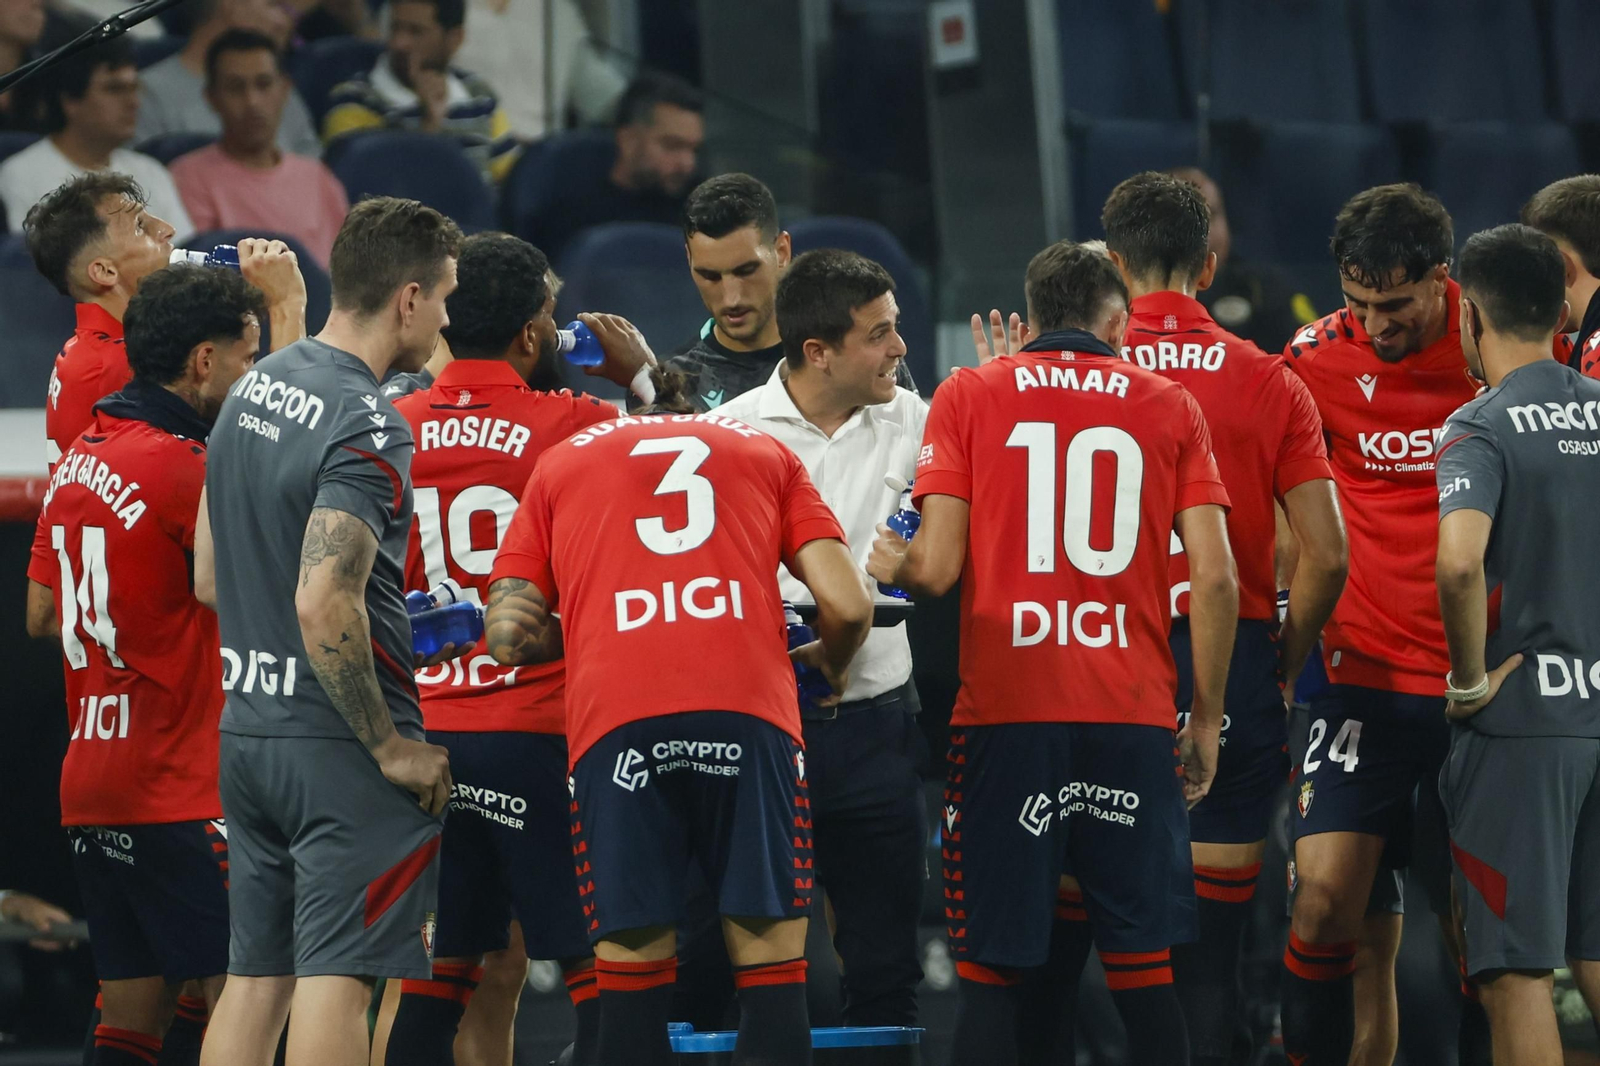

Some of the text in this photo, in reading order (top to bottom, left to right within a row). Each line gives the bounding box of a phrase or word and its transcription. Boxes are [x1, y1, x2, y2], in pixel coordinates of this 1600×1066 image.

[1119, 341, 1226, 372] TORRÓ
[1015, 366, 1130, 398] AIMAR
[232, 370, 325, 430] macron
[1506, 400, 1600, 433] macr
[238, 412, 280, 443] OSASUNA
[421, 415, 531, 458] ROSIER
[569, 413, 763, 447] JUAN CRUZ
[1558, 439, 1600, 456] OSASU
[77, 454, 147, 531] GARCÍA
[628, 435, 717, 555] 3
[1004, 421, 1144, 577] 10
[51, 525, 126, 671] 14
[614, 576, 744, 632] DIGI
[1012, 600, 1129, 648] DIGI
[219, 647, 297, 696] DIGI
[652, 740, 743, 760] CRYPTO
[1303, 718, 1363, 776] 24
[656, 759, 740, 776] FUND TRADER
[449, 783, 527, 815] CRYPTO
[1058, 781, 1140, 810] CRYPTO
[478, 807, 525, 831] TRADER
[1059, 802, 1136, 827] FUND TRADER
[101, 845, 136, 867] TRADER
